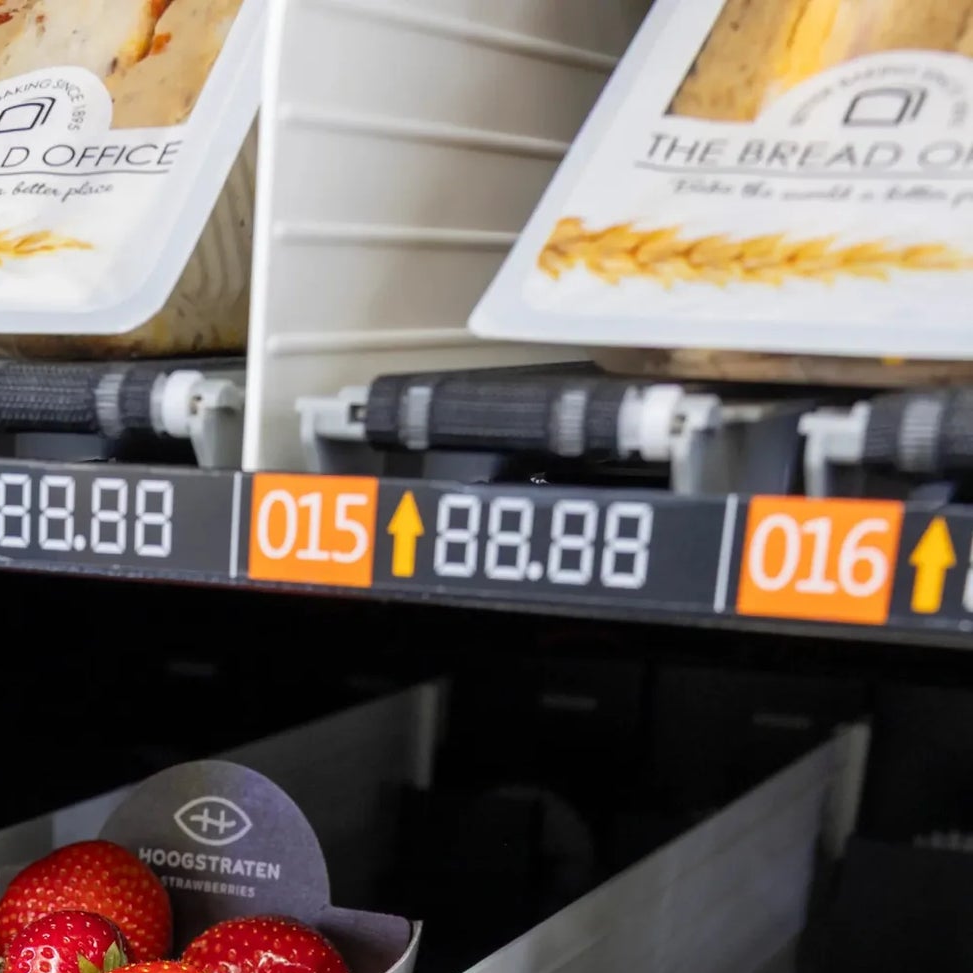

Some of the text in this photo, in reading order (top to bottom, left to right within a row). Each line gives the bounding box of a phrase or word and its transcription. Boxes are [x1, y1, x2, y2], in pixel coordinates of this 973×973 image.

[41, 141, 184, 168] OFFICE
[646, 133, 729, 163] THE
[736, 137, 904, 169] BREAD
[256, 488, 654, 589] 015 88.88
[748, 512, 890, 598] 016
[138, 847, 281, 881] HOOGSTRATEN
[160, 875, 256, 898] STRAWBERRIES
